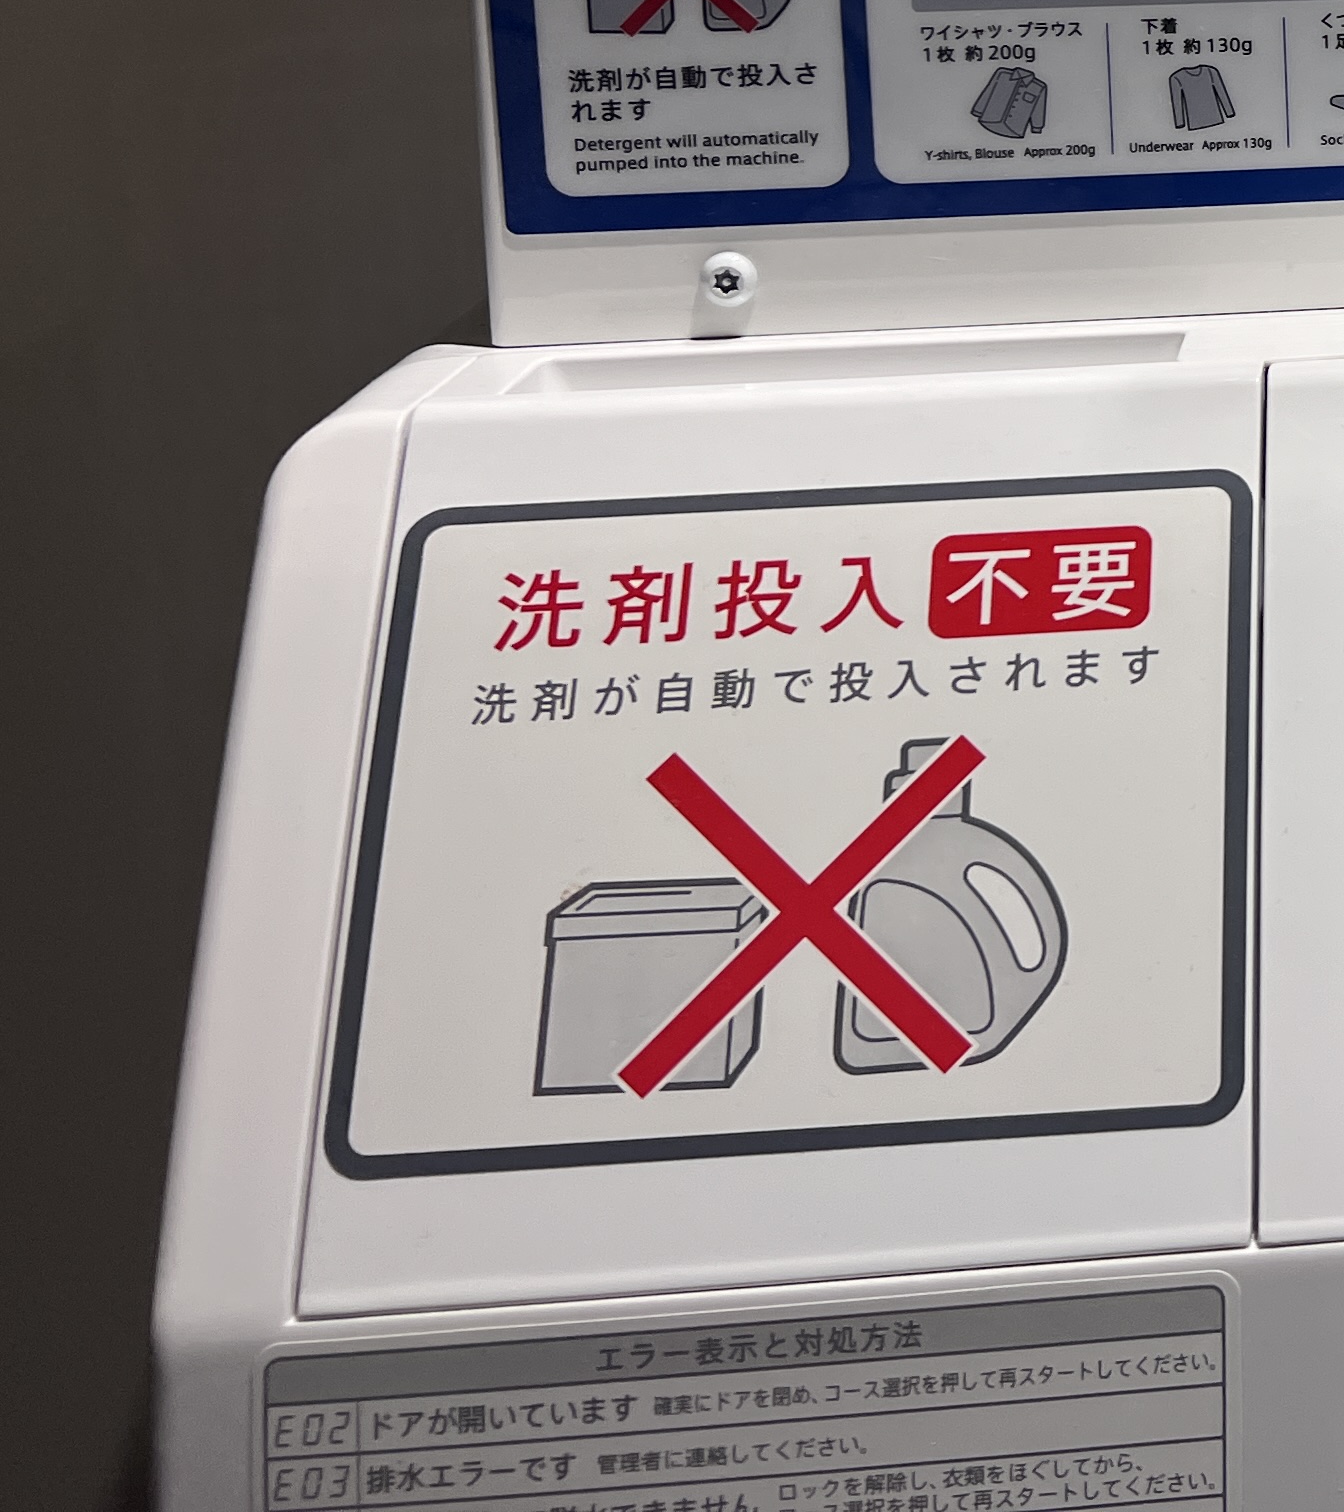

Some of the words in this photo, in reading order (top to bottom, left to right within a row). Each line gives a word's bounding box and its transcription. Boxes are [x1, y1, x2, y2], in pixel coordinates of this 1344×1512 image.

[494, 557, 903, 651] 洗剤投入
[946, 542, 1136, 624] 不要
[472, 646, 1159, 725] 洗剤が自動で投入されます
[596, 1321, 923, 1373] エラー表示と対処方法
[274, 1412, 350, 1448] E02
[374, 1395, 637, 1440] ドアが開いています
[273, 1465, 350, 1502] E03
[367, 1454, 576, 1494] 排水エラーです
